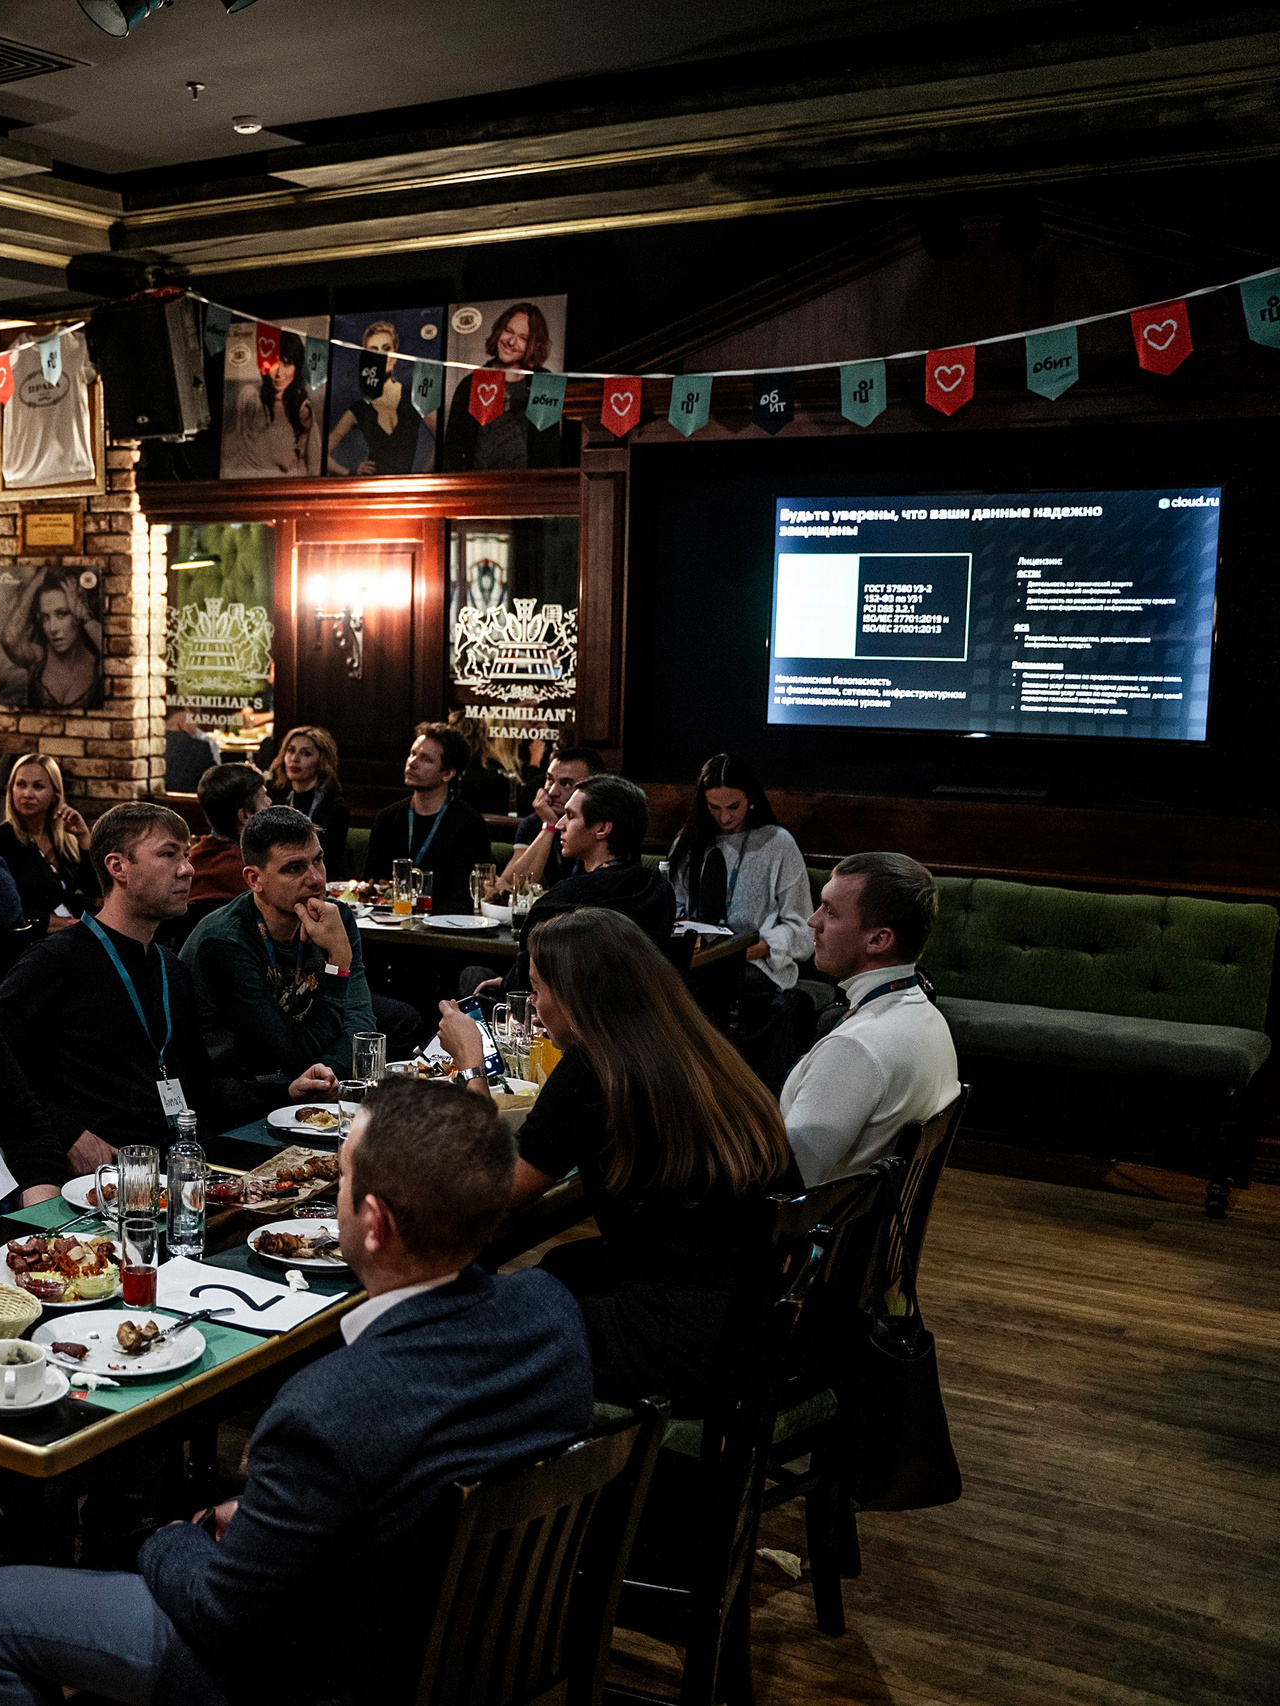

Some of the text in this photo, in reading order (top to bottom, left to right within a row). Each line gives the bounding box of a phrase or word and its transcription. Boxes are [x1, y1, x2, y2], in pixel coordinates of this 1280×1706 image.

[1032, 355, 1073, 374] обит
[1171, 495, 1220, 508] cloud.ru
[780, 505, 1103, 524] Будьте уверены, что ваши данные надежно
[779, 525, 858, 538] защищены
[864, 584, 886, 593] ГОСТ
[863, 605, 915, 614] PCI DSS 3.2.1
[862, 614, 893, 623] ISO/IEC
[862, 624, 892, 633] ISO/IEC
[489, 726, 560, 740] KARAOKE
